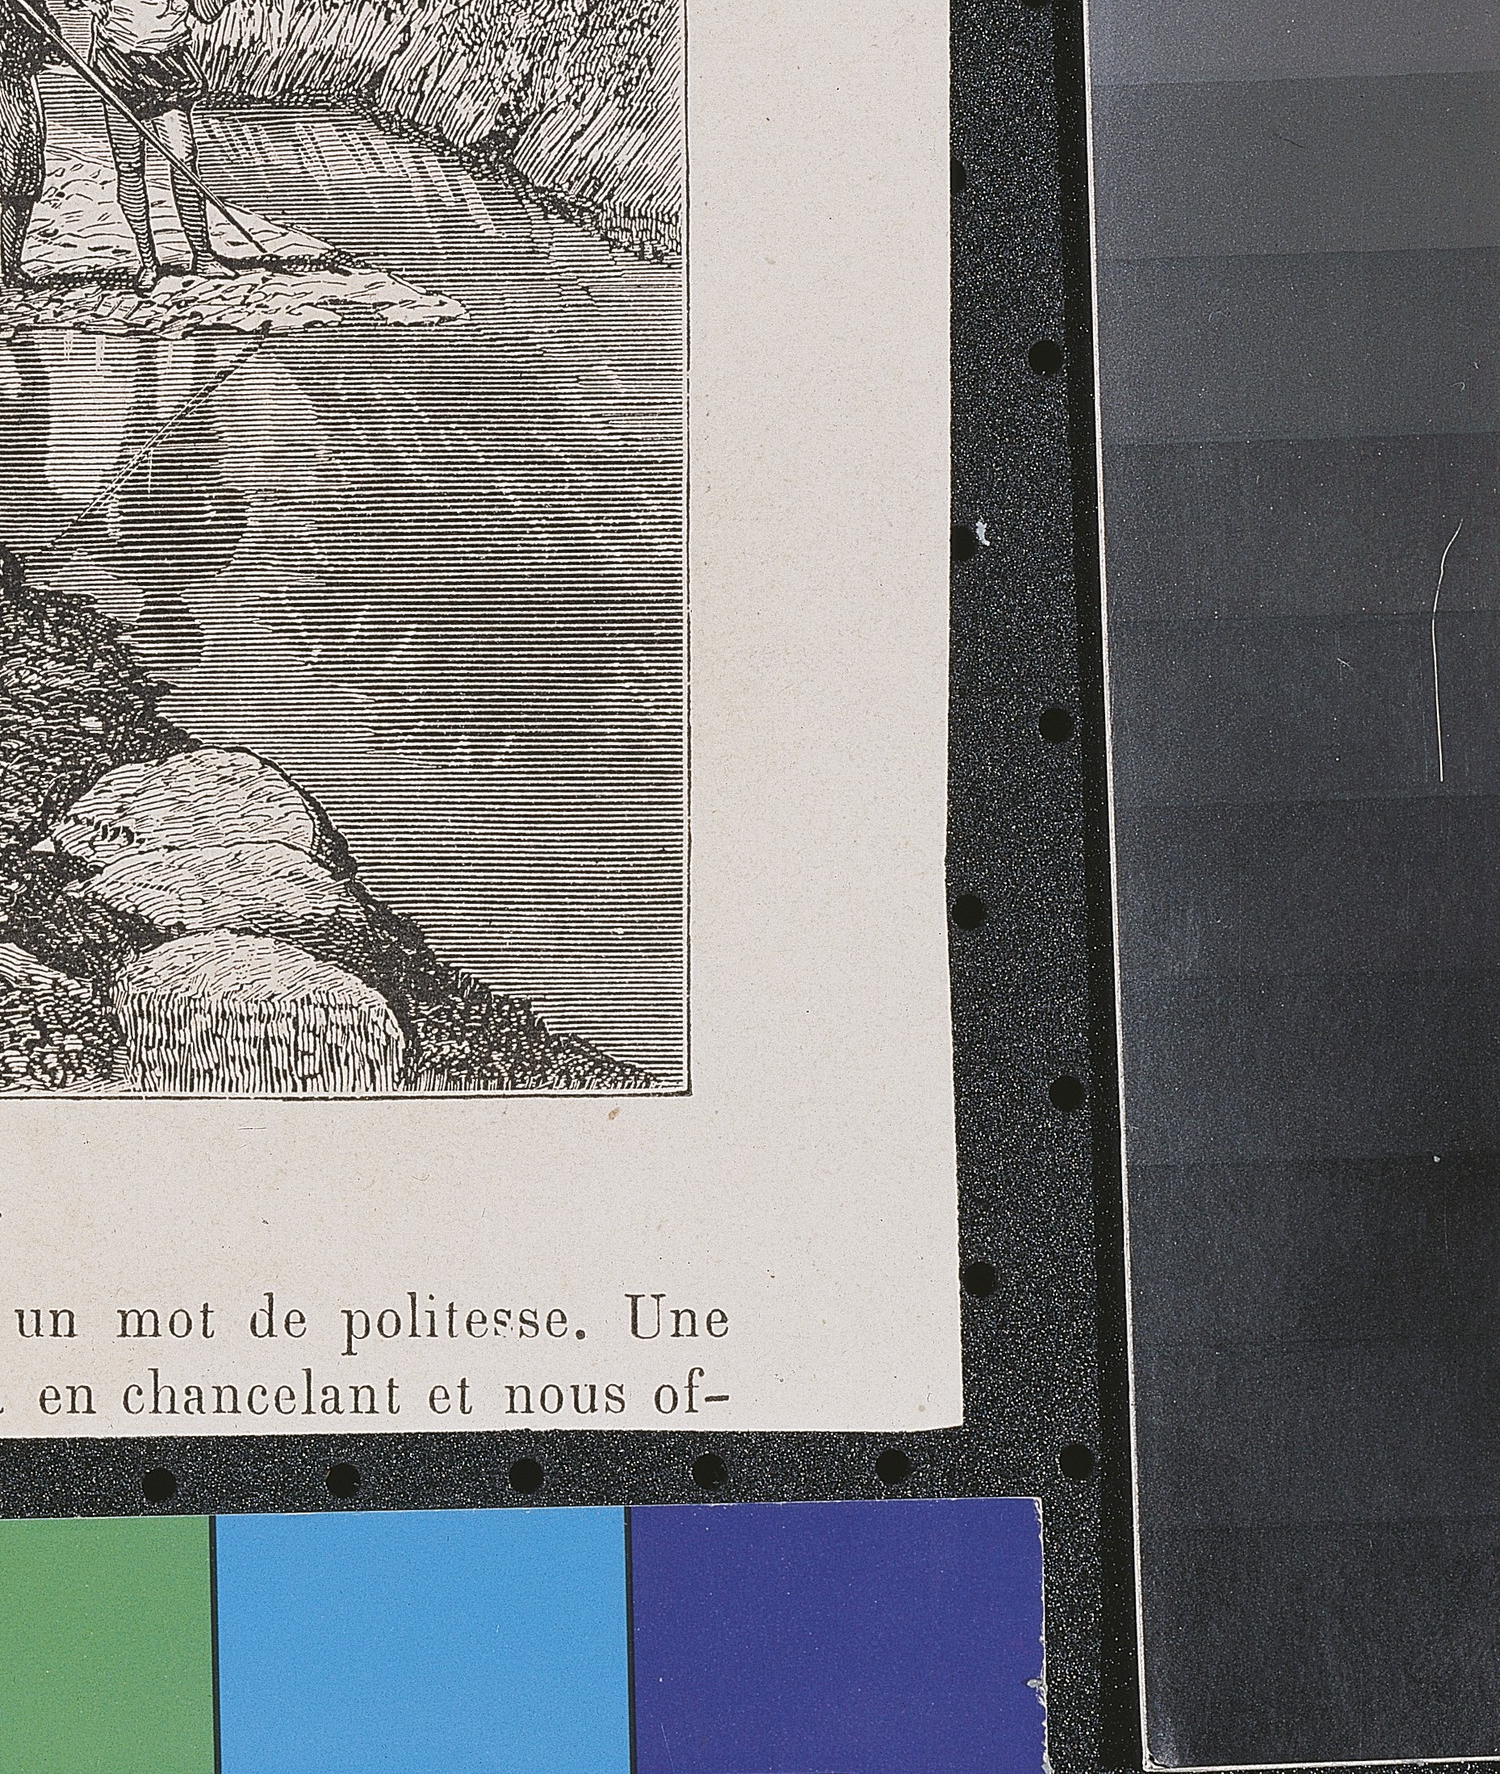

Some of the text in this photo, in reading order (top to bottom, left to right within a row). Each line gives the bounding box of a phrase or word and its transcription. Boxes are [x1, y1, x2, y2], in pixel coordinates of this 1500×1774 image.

[14, 1308, 78, 1338] un
[116, 1302, 215, 1339] mot
[249, 1291, 307, 1339] de
[340, 1291, 586, 1357] politesse.
[624, 1293, 729, 1340] Une
[38, 1384, 97, 1415] en
[122, 1367, 401, 1416] chancelant
[428, 1377, 473, 1415] et
[504, 1383, 626, 1415] nous
[654, 1367, 730, 1415] of-
